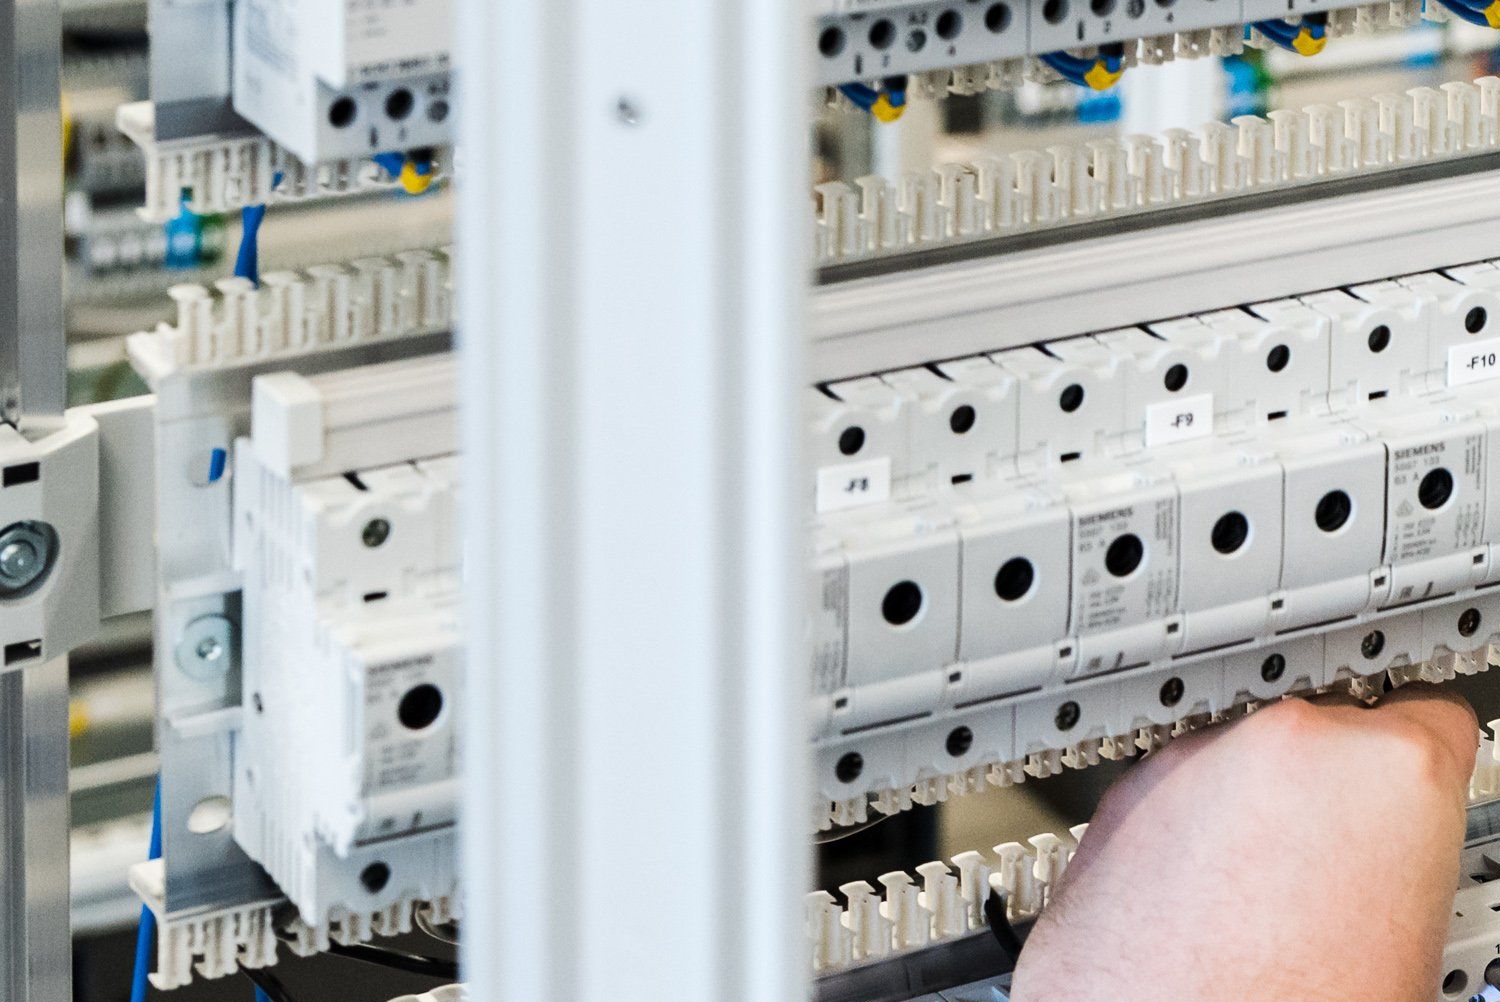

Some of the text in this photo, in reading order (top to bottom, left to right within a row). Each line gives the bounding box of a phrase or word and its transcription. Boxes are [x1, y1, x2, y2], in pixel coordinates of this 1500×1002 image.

[1466, 353, 1496, 370] -F10
[1170, 412, 1193, 428] -F9
[1394, 442, 1445, 459] SIEMENS
[1495, 944, 1500, 954] 1
